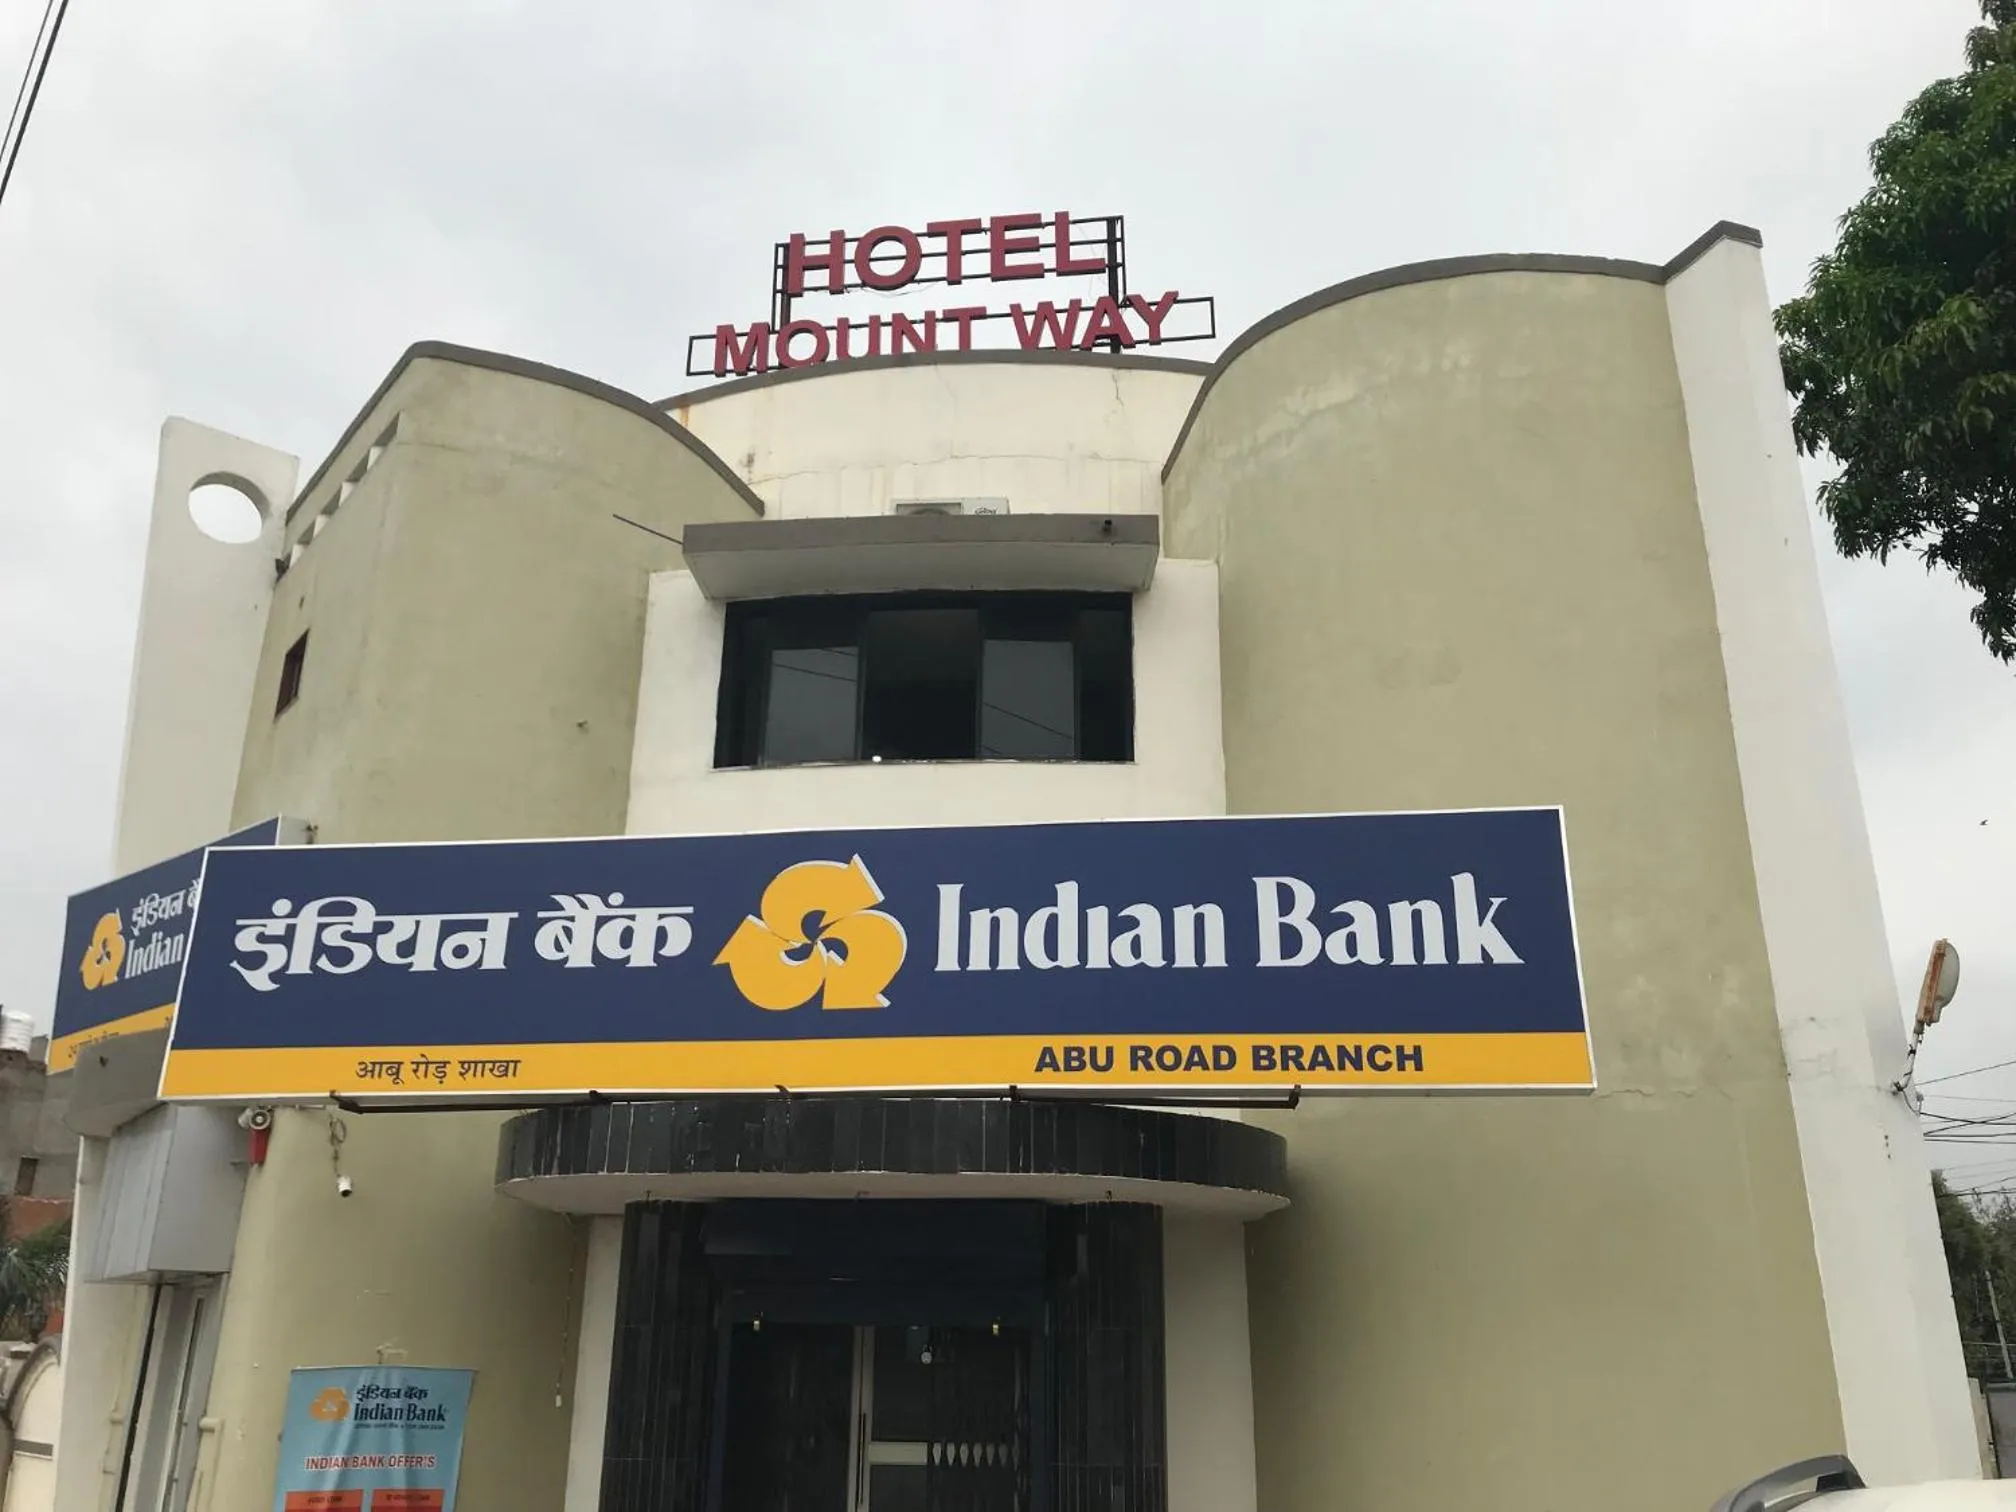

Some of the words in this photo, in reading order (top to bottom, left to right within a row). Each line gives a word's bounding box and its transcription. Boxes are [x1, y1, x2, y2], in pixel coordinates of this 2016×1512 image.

[788, 211, 1107, 297] HOTEL
[714, 307, 987, 377] MOUNT
[1009, 291, 1179, 351] WAY
[230, 895, 518, 991] इंडियन
[534, 892, 694, 969] बैंक
[934, 881, 1228, 971] Indian
[1252, 872, 1525, 968] Bank
[125, 931, 184, 979] Indian
[355, 1061, 405, 1084] आबू
[410, 1053, 451, 1084] रोड़
[458, 1059, 522, 1081] शाखा
[1034, 1046, 1115, 1073] ABU
[1129, 1045, 1237, 1072] ROAD
[1251, 1044, 1425, 1072] BRANCH
[354, 1402, 404, 1422] Indian
[406, 1402, 446, 1422] Bank
[304, 1456, 349, 1470] INDIAN
[351, 1455, 385, 1469] BANK
